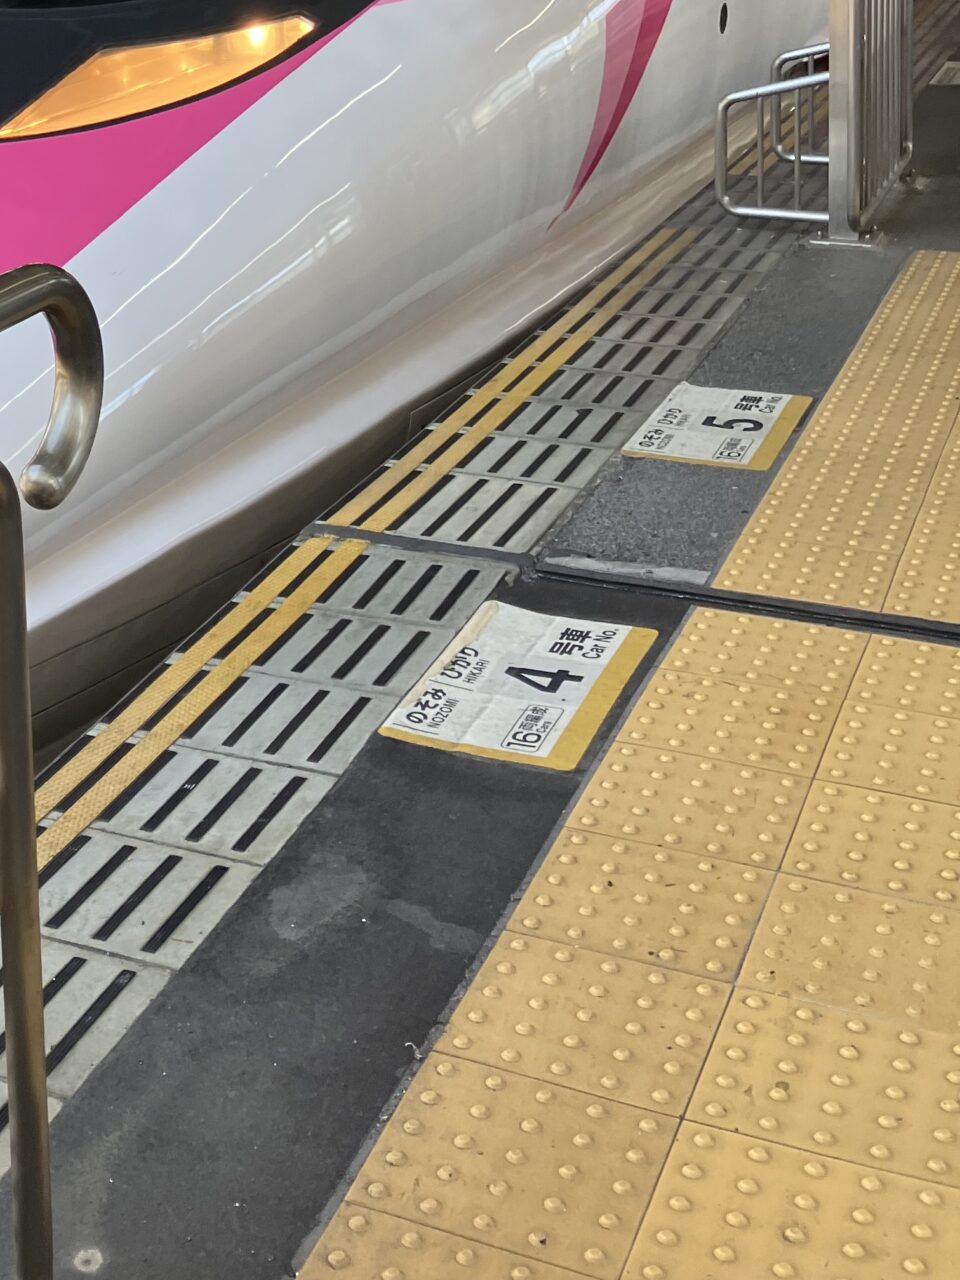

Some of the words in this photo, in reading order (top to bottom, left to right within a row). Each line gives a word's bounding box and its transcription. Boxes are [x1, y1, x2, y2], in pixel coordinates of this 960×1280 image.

[702, 416, 763, 431] 5
[734, 395, 763, 411] 号車
[639, 429, 664, 447] のぞみ
[716, 451, 741, 460] 16
[593, 628, 620, 643] No.
[440, 646, 479, 679] ひかり
[505, 667, 584, 693] 4
[548, 627, 592, 655] 号車
[581, 644, 607, 659] Car
[463, 659, 490, 684] HIKARI
[406, 688, 446, 724] のぞみ
[427, 698, 460, 729] NOZOMI
[506, 731, 542, 748] 16
